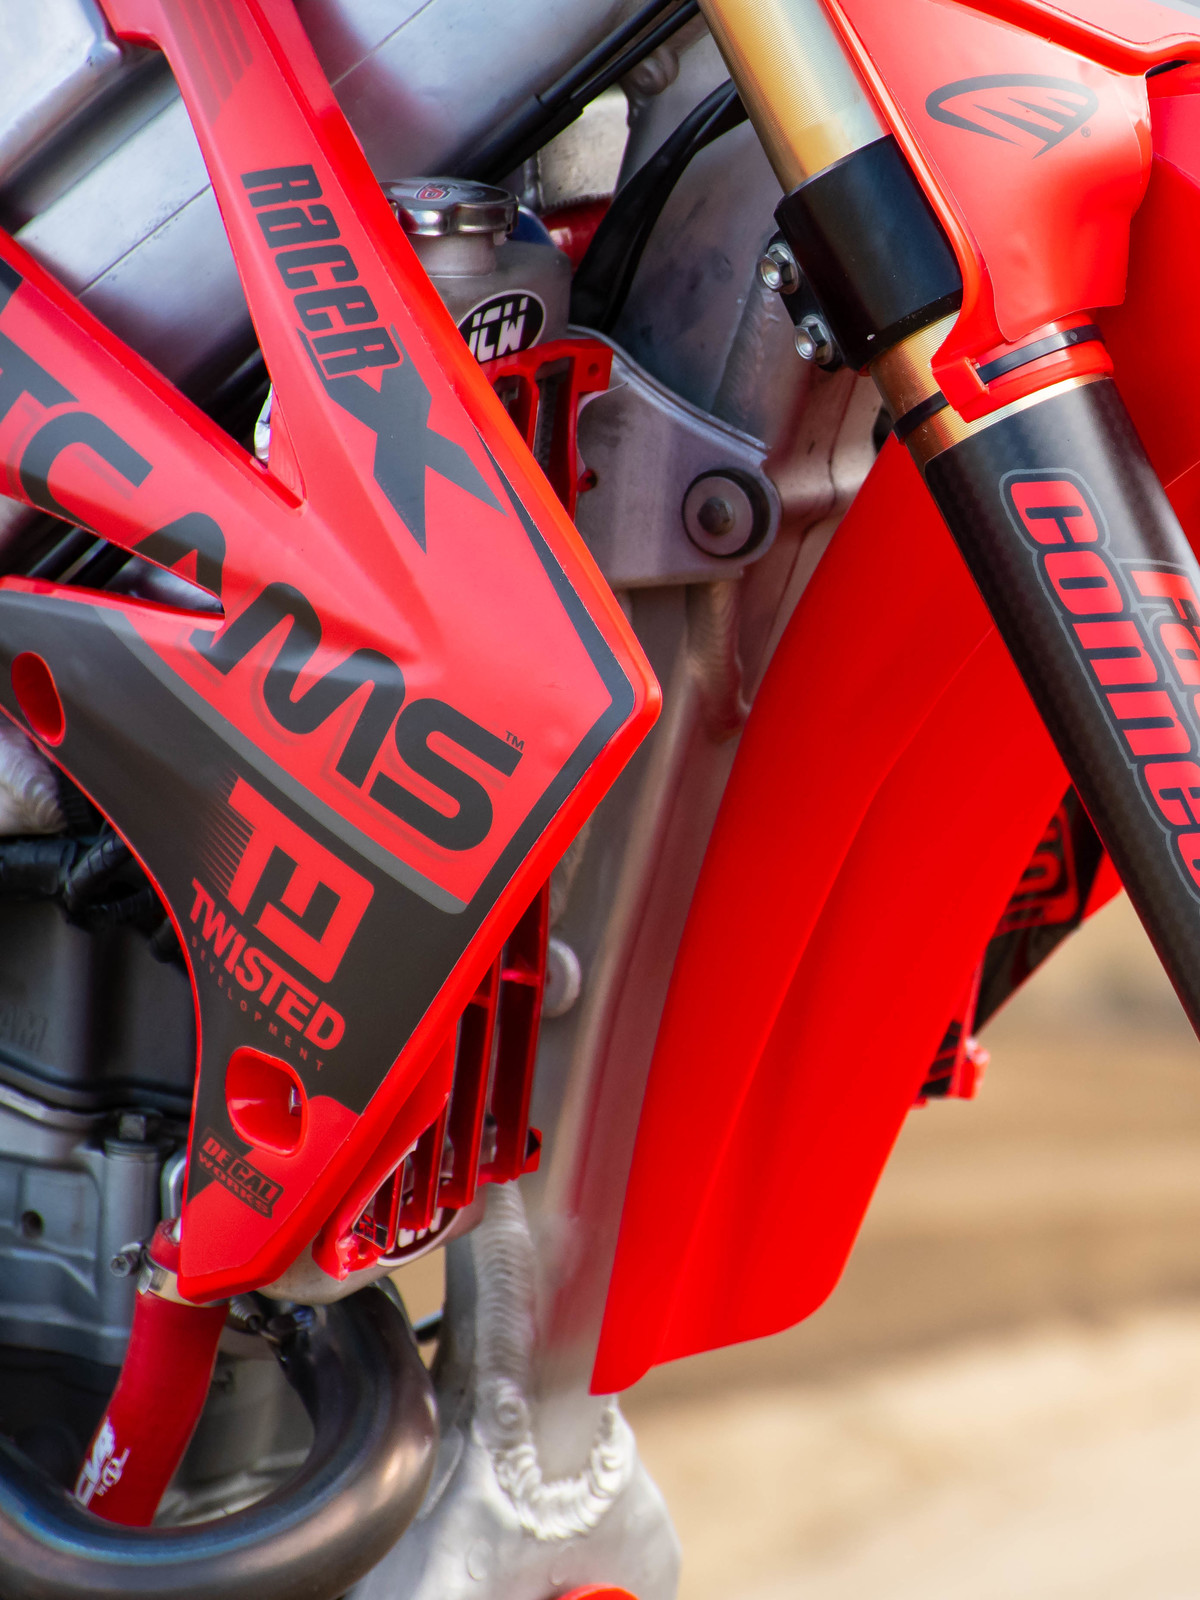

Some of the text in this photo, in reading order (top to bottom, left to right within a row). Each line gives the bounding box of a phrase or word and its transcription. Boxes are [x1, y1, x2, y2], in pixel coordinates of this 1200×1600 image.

[297, 323, 510, 554] X
[190, 877, 345, 1050] TWISTED
[192, 936, 323, 1071] DEVELOPMENT
